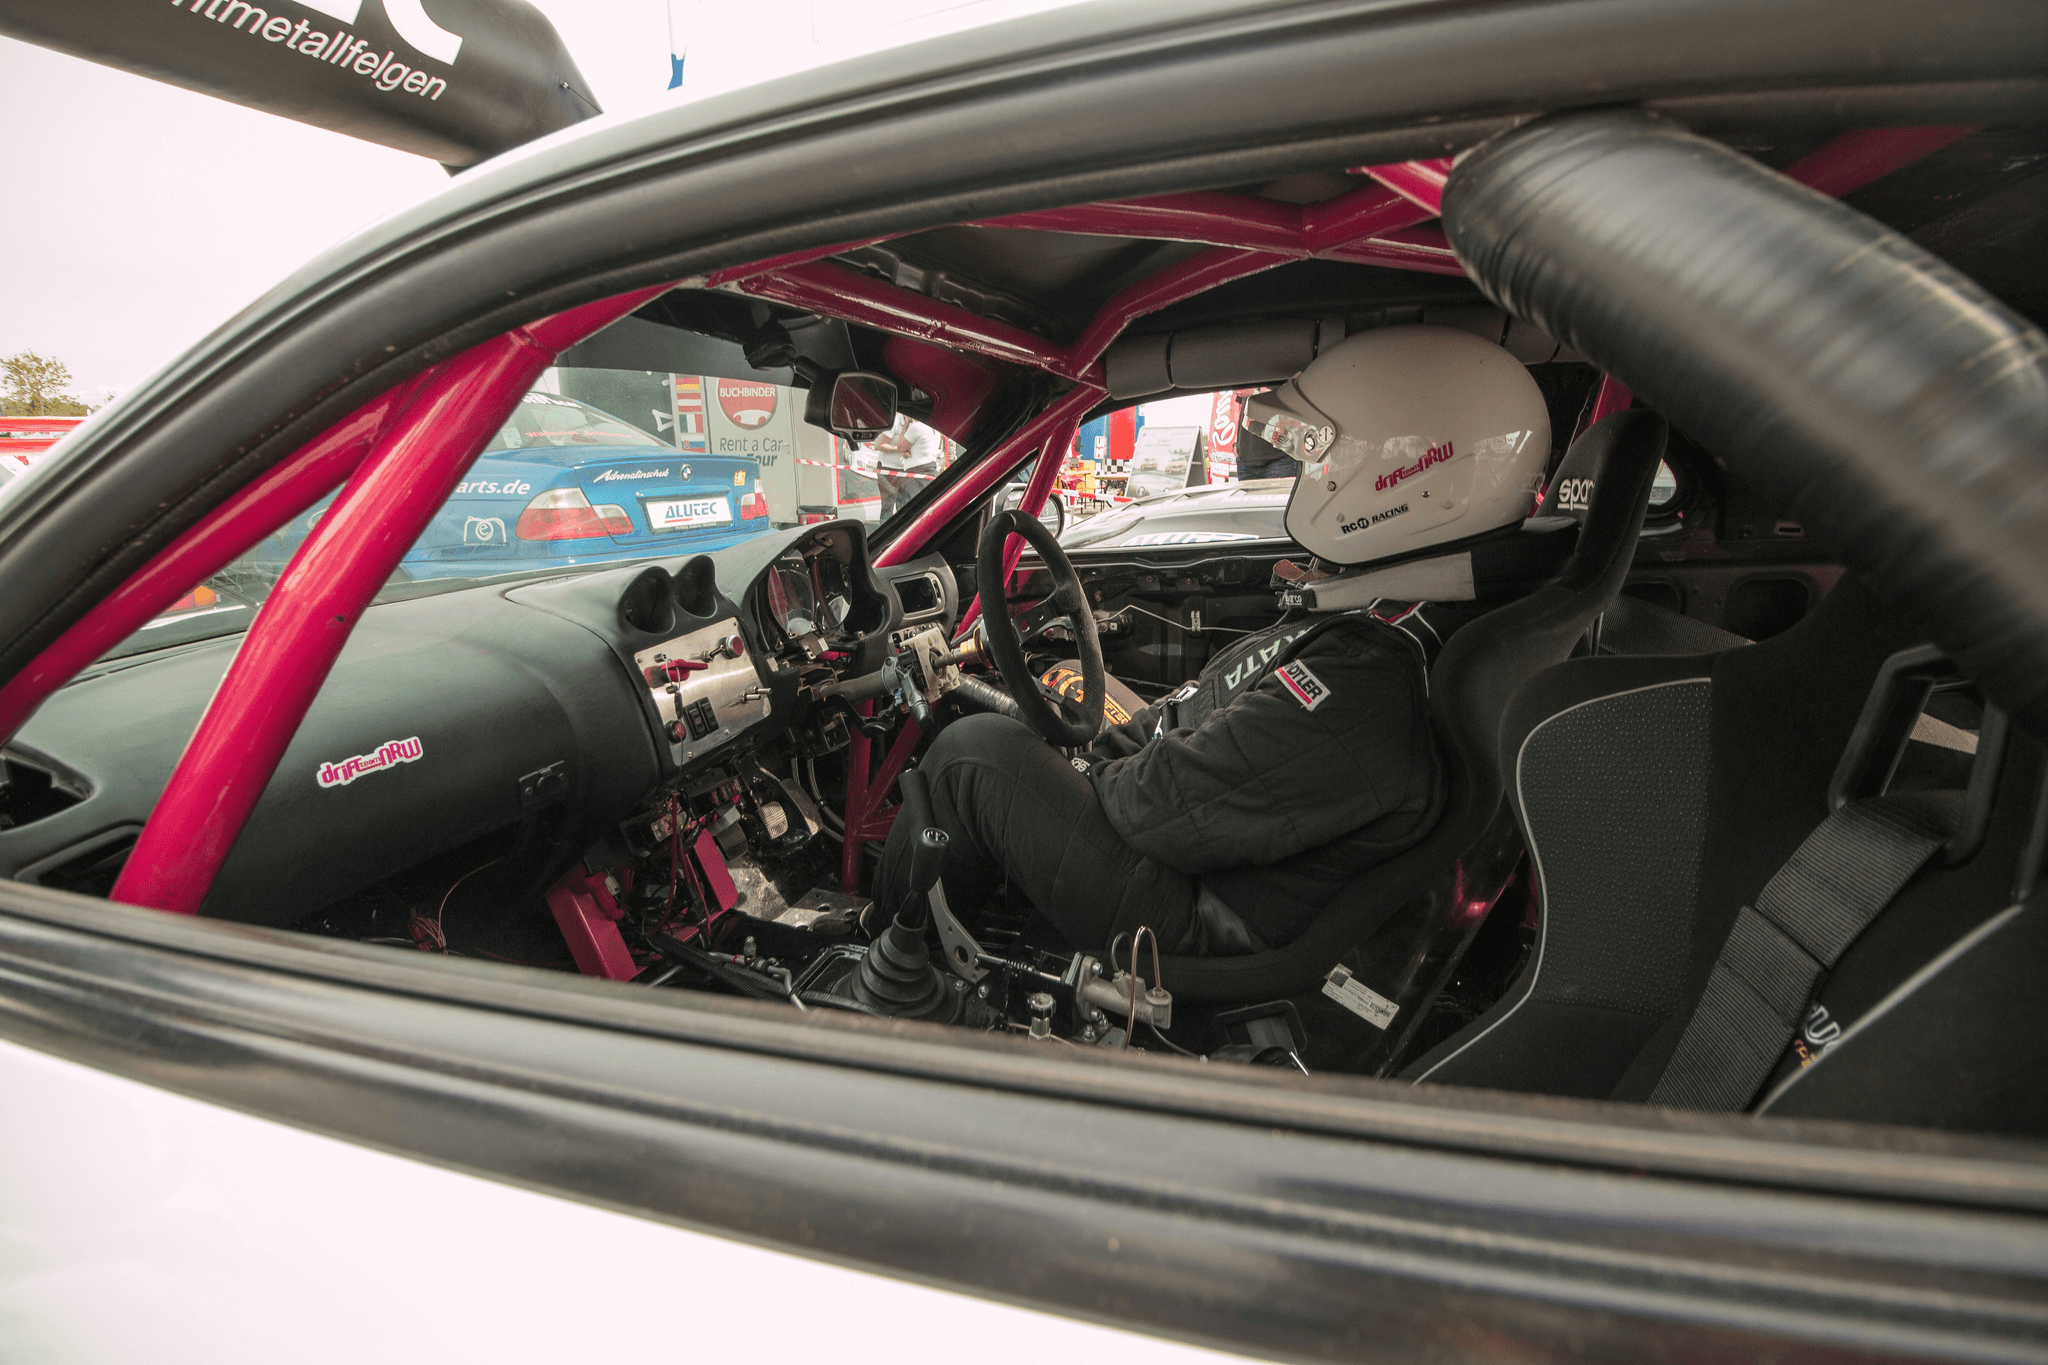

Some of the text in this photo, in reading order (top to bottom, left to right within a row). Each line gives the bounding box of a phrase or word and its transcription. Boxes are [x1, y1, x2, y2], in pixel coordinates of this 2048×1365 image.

[719, 386, 776, 398] BUCHBINDER
[719, 437, 783, 452] Rent a Car
[593, 468, 670, 484] Adrenalinschub
[664, 501, 718, 519] ALUTEC
[1371, 503, 1410, 525] RACING
